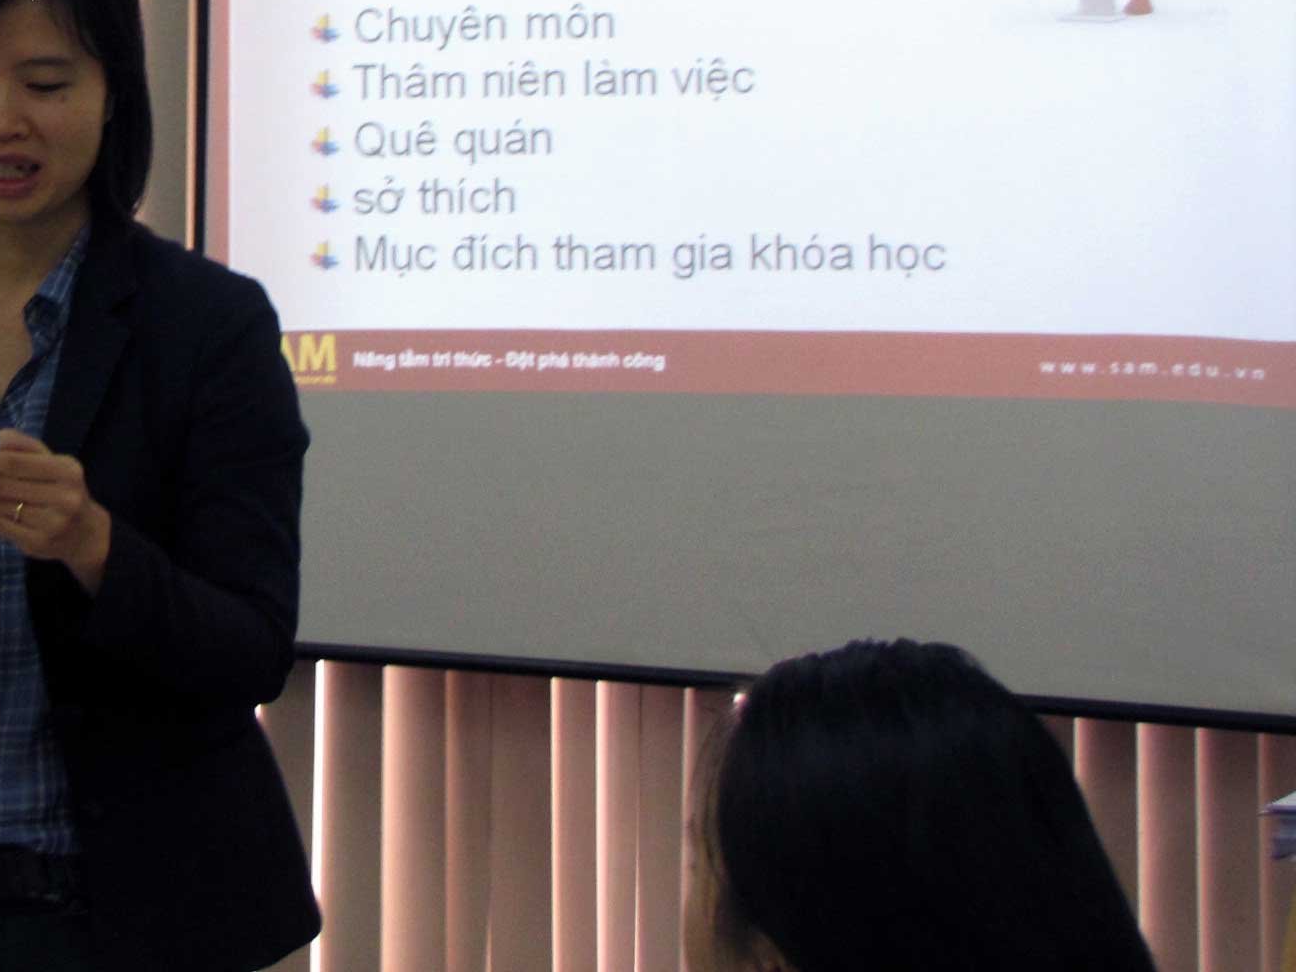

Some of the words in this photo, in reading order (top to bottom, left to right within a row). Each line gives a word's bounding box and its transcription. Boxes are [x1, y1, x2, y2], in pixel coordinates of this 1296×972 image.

[354, 5, 507, 51] Chuyên
[525, 2, 616, 40] môn
[353, 62, 467, 101] Thâm
[481, 59, 567, 98] niên
[585, 57, 658, 96] làm
[672, 56, 756, 101] việc
[354, 120, 438, 161] Quê
[453, 119, 554, 165] quán
[353, 176, 406, 216] sở
[418, 176, 517, 215] thích
[354, 234, 437, 280] Mục
[451, 232, 538, 272] đích
[553, 232, 657, 271] tham
[672, 234, 734, 281] gia
[750, 231, 855, 271] khóa
[868, 231, 948, 279] học
